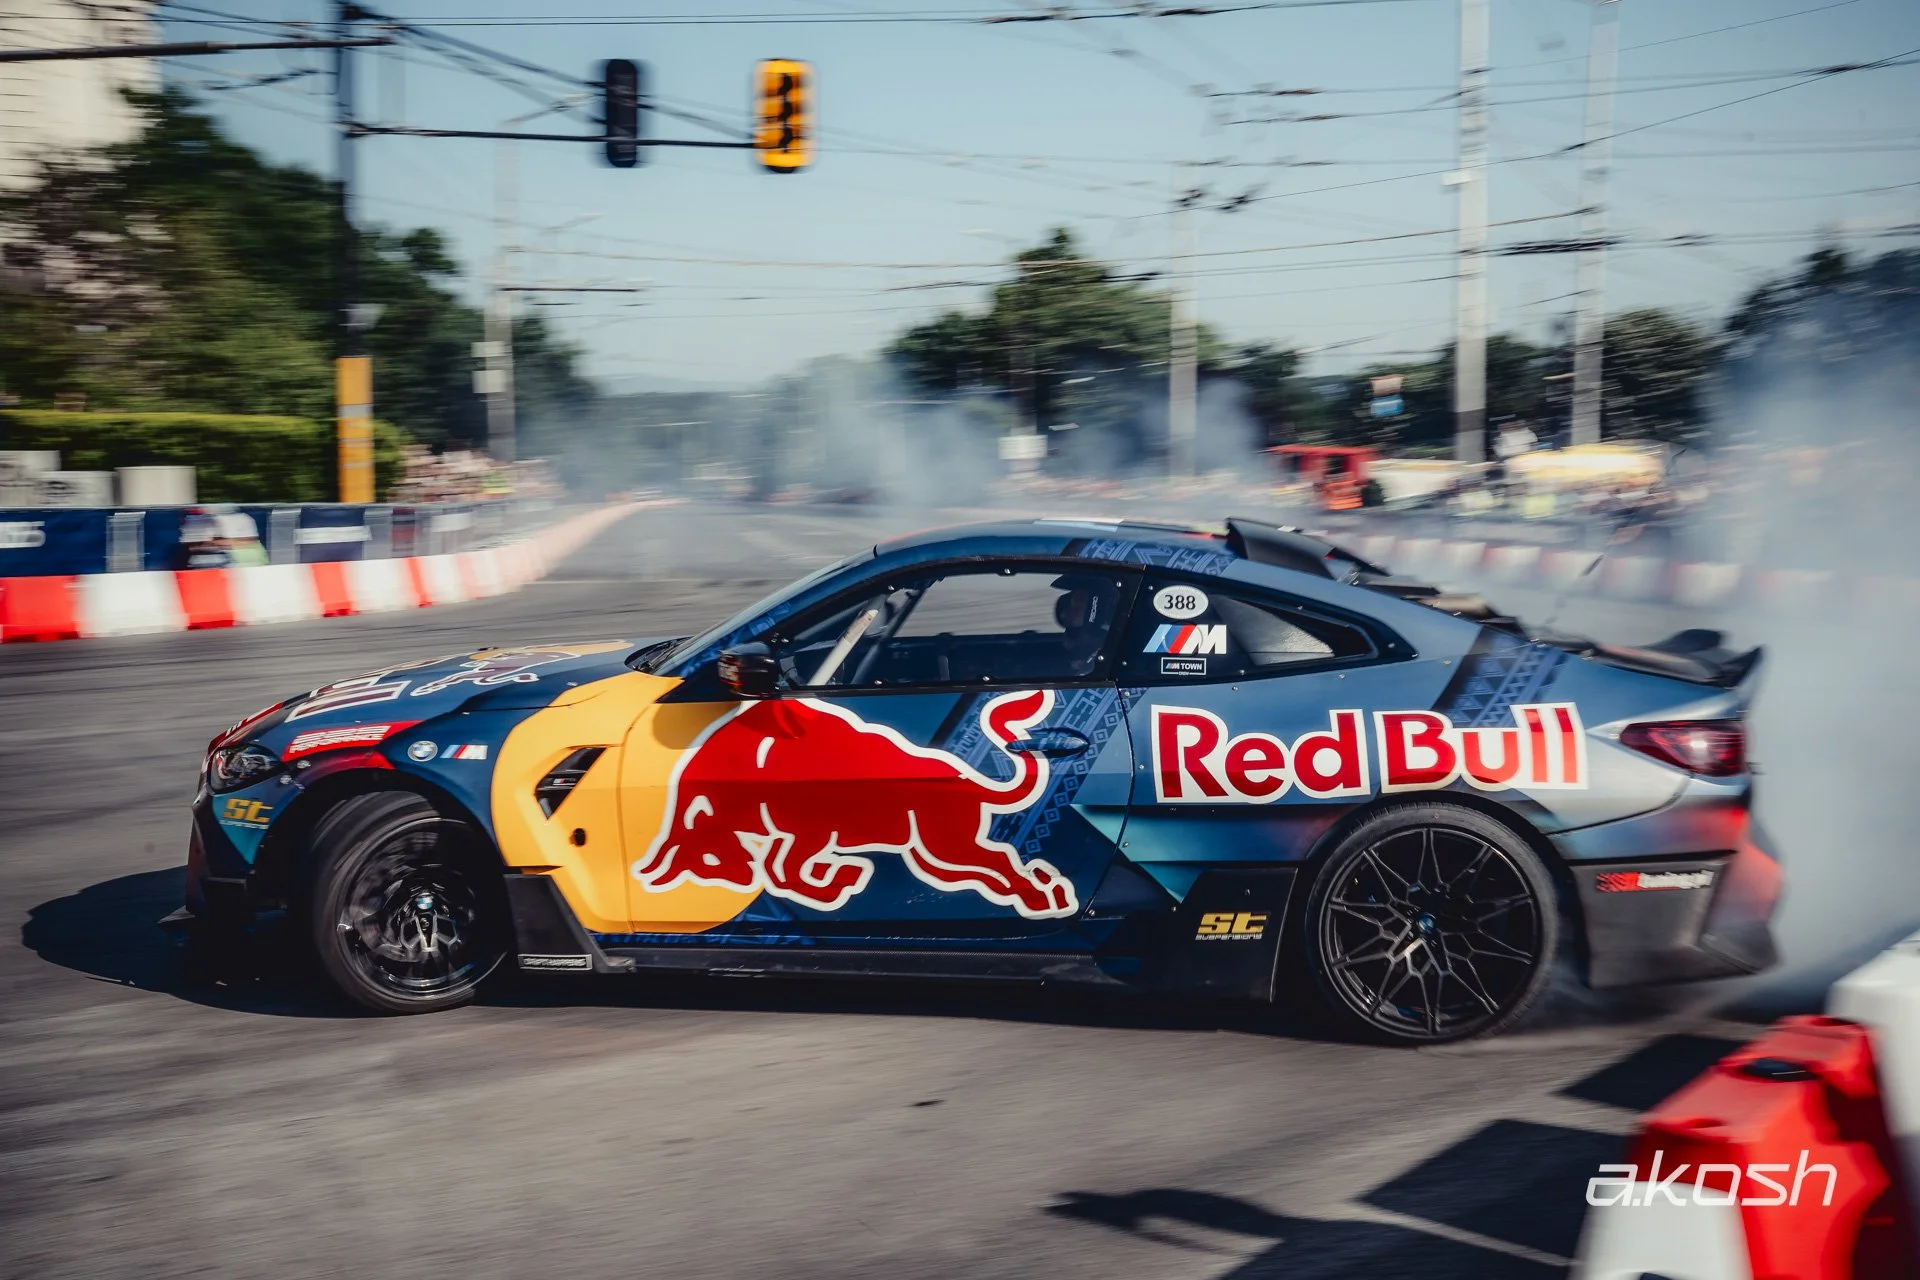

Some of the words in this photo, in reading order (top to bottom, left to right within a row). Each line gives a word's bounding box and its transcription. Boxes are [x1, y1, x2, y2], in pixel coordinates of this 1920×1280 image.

[1164, 594, 1196, 610] 388
[1180, 662, 1203, 670] TOWN
[1157, 711, 1362, 798] Red
[1383, 706, 1580, 787] Bull
